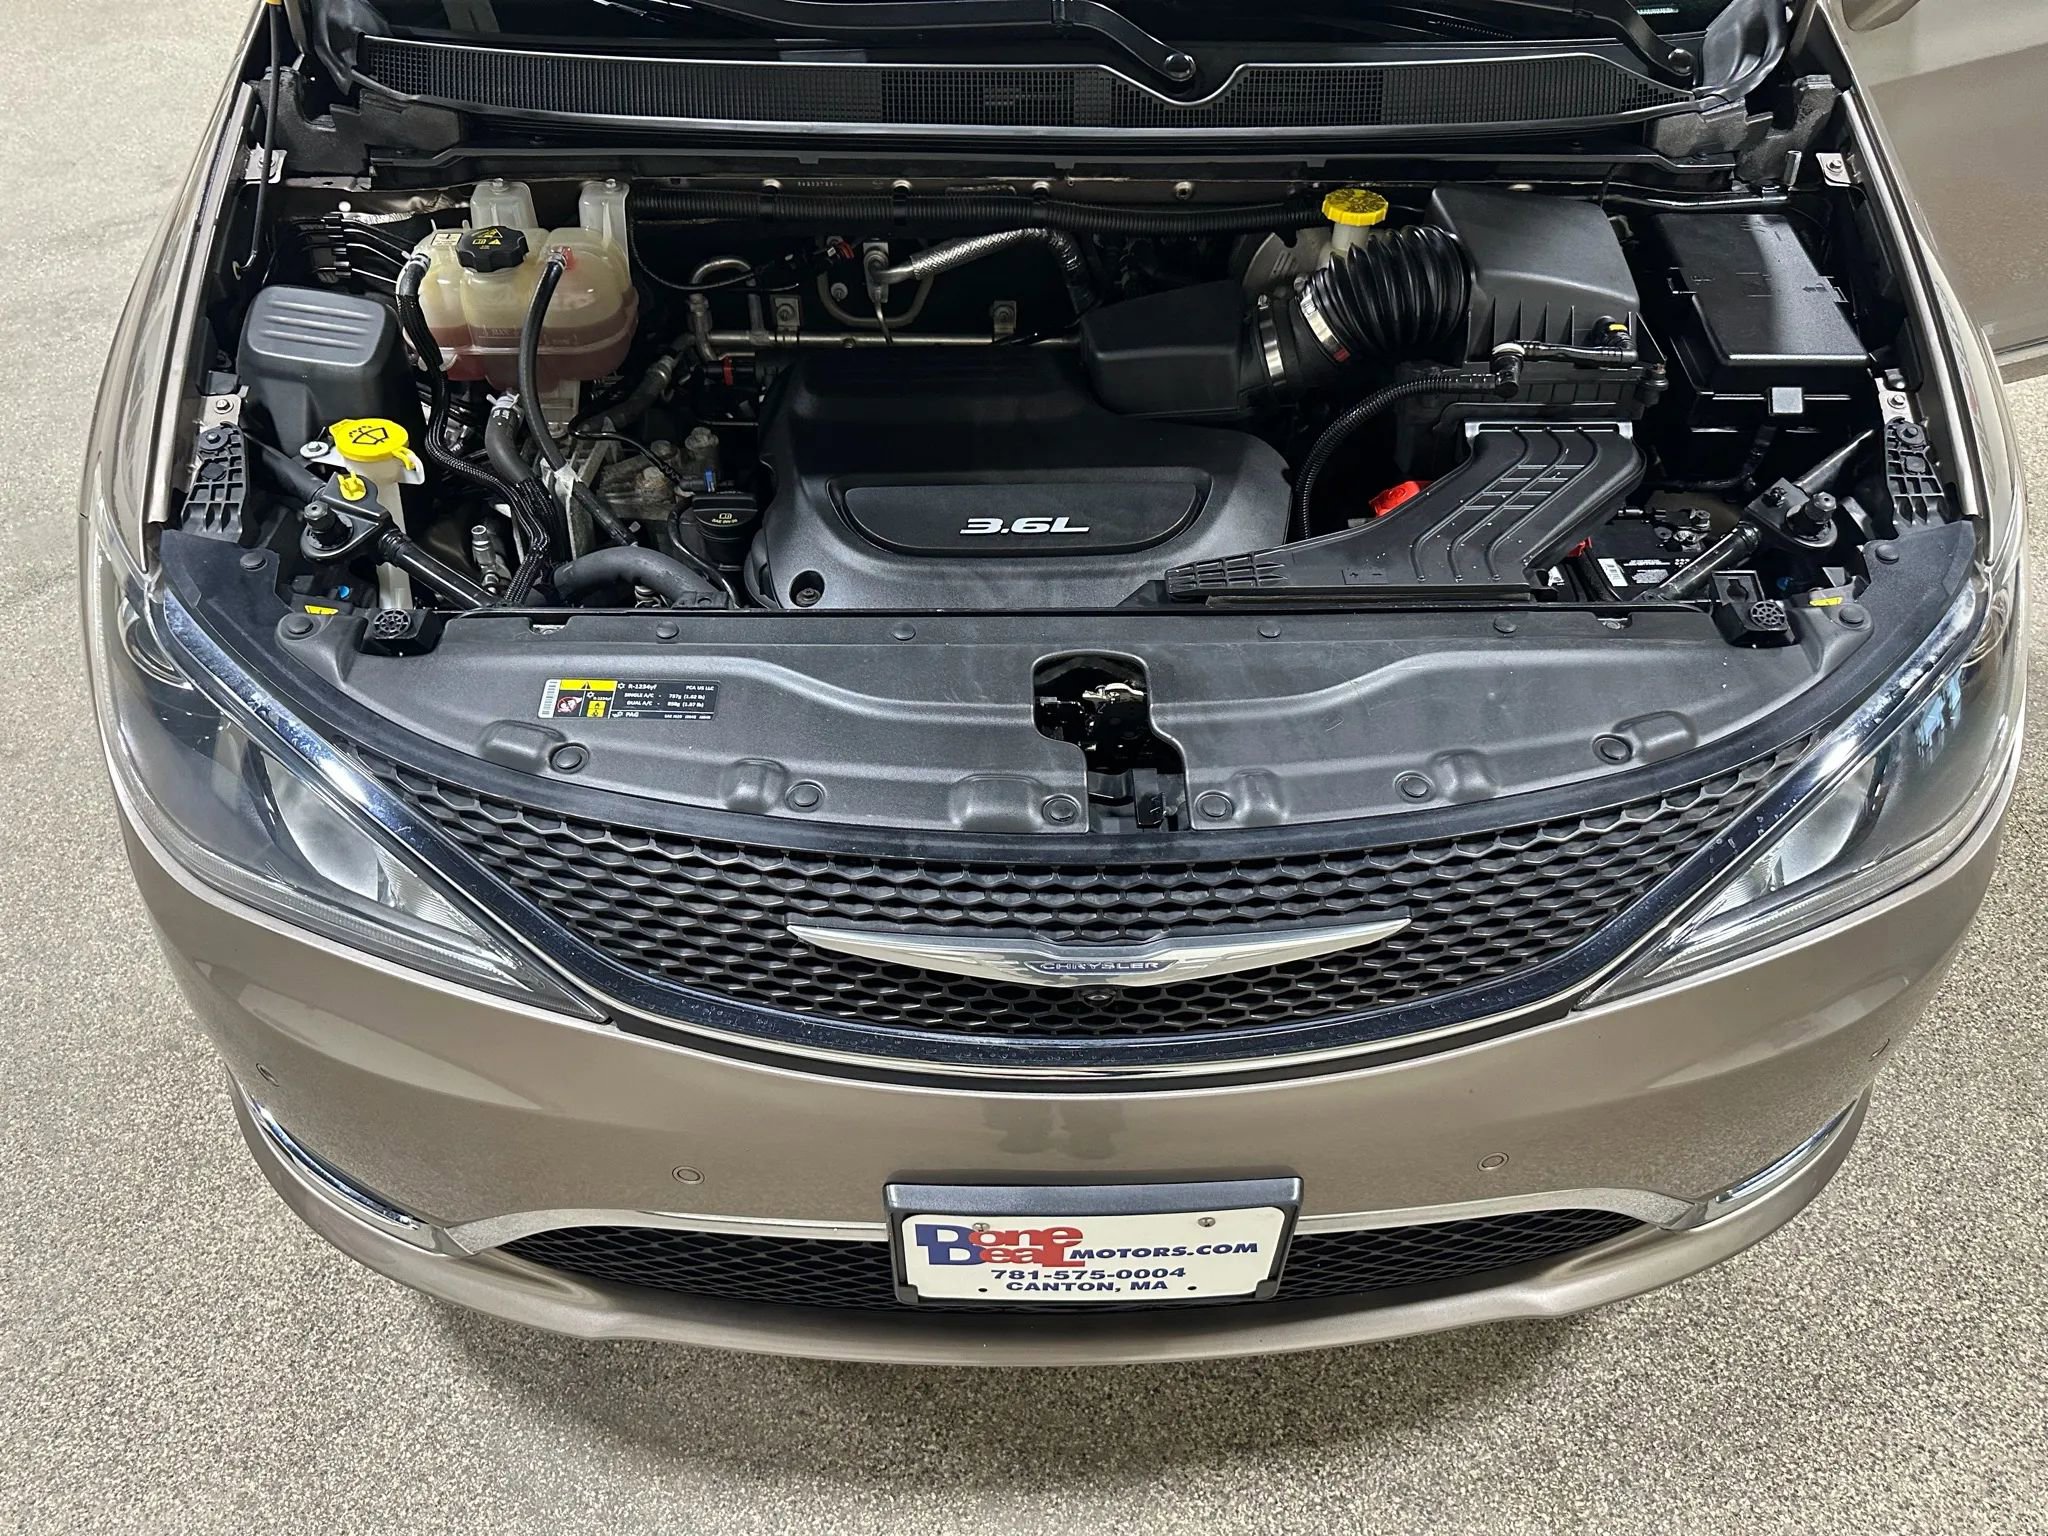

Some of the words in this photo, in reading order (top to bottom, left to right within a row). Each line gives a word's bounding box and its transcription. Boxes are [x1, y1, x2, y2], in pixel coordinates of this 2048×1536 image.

[960, 517, 1090, 534] 3.6L
[628, 683, 657, 691] R-1234yf
[1040, 961, 1160, 970] CHRYSLER
[1069, 1242, 1259, 1260] MOTORS.COM
[990, 1266, 1187, 1281] 781-575-0004
[1006, 1280, 1122, 1293] CANTON,
[1129, 1280, 1169, 1291] MA
